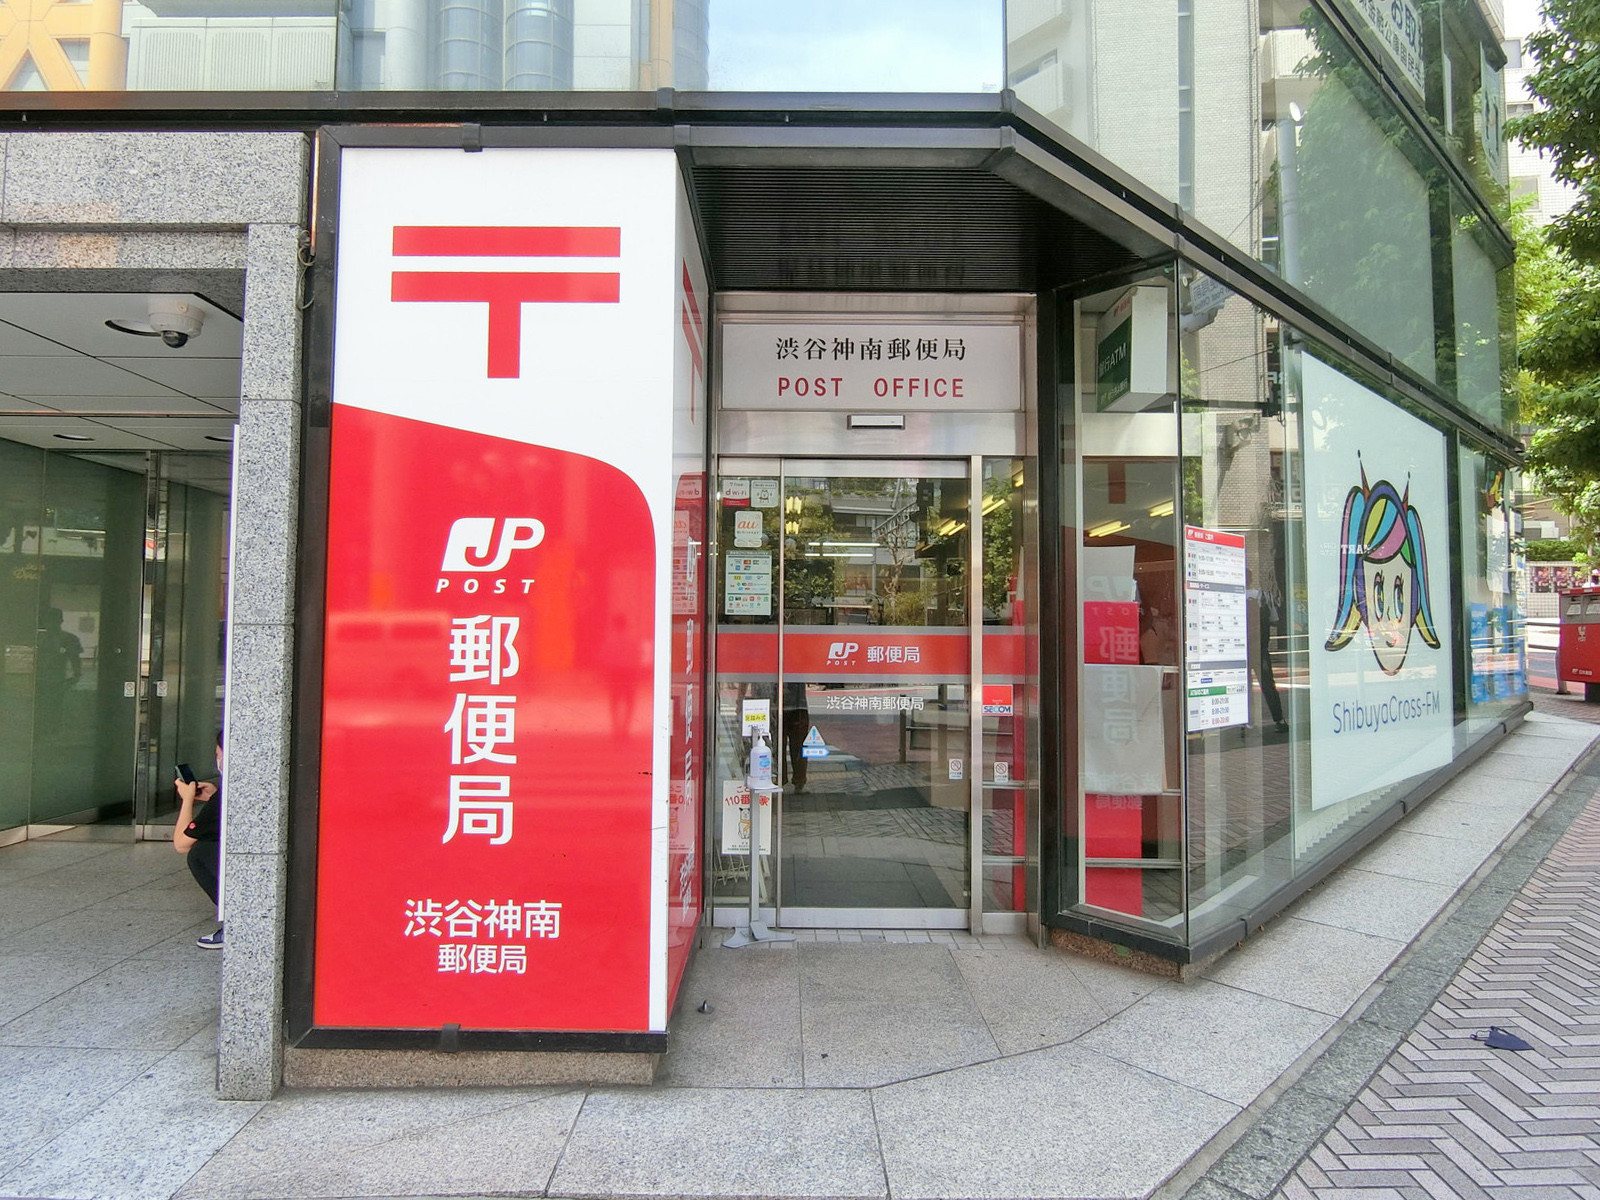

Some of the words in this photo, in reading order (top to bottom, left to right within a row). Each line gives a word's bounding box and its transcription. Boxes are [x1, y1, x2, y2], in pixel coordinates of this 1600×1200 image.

[1391, 0, 1423, 60] お取
[776, 337, 966, 361] 渋谷神南郵便局
[778, 377, 843, 397] POST
[873, 377, 964, 398] OFFICE
[737, 520, 759, 529] au
[435, 578, 535, 594] POST
[867, 646, 920, 664] 郵便局
[826, 695, 924, 711] 渋谷神南郵便局
[983, 706, 1011, 714] SECOM
[1332, 690, 1440, 734] ShibuyaCross-FM
[442, 614, 521, 845] 郵便局
[403, 898, 563, 939] 渋谷神南
[437, 943, 528, 975] 郵便局
